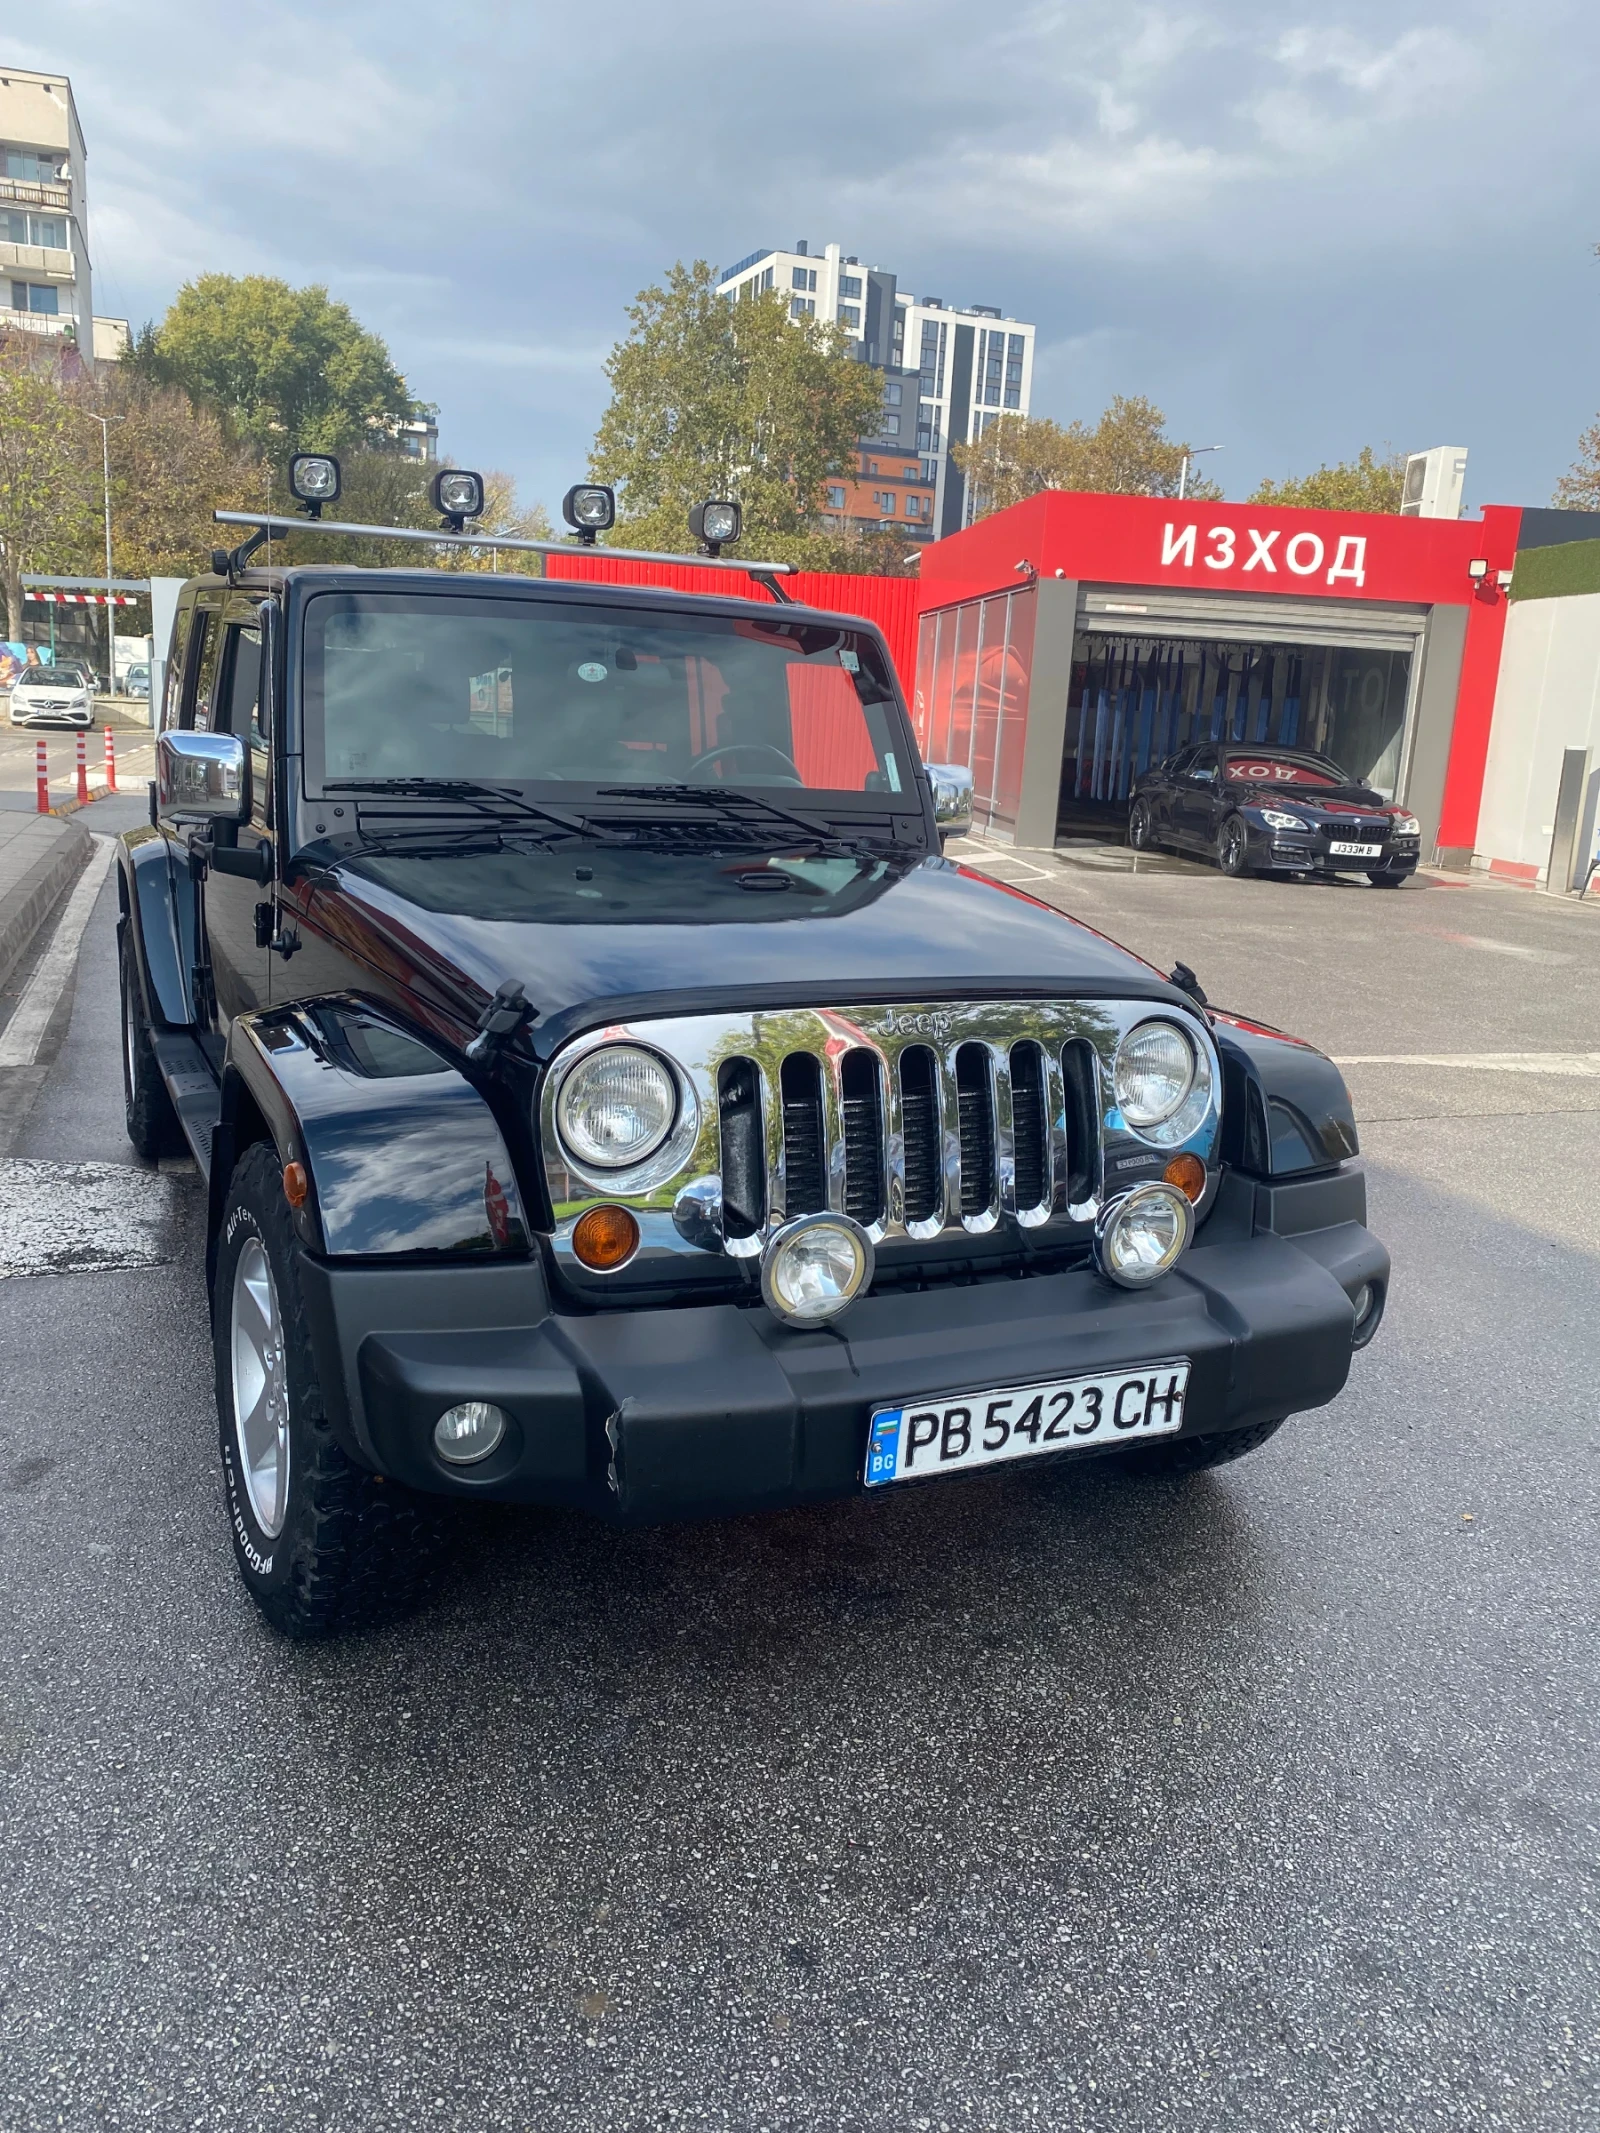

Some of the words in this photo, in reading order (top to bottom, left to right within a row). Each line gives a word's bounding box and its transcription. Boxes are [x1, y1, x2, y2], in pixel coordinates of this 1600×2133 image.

[1160, 522, 1367, 587] ИЗХОД
[877, 1008, 953, 1039] Jeep
[904, 1407, 972, 1468] PB
[982, 1386, 1104, 1451] 5423
[1112, 1375, 1181, 1430] CH
[872, 1454, 894, 1473] BG
